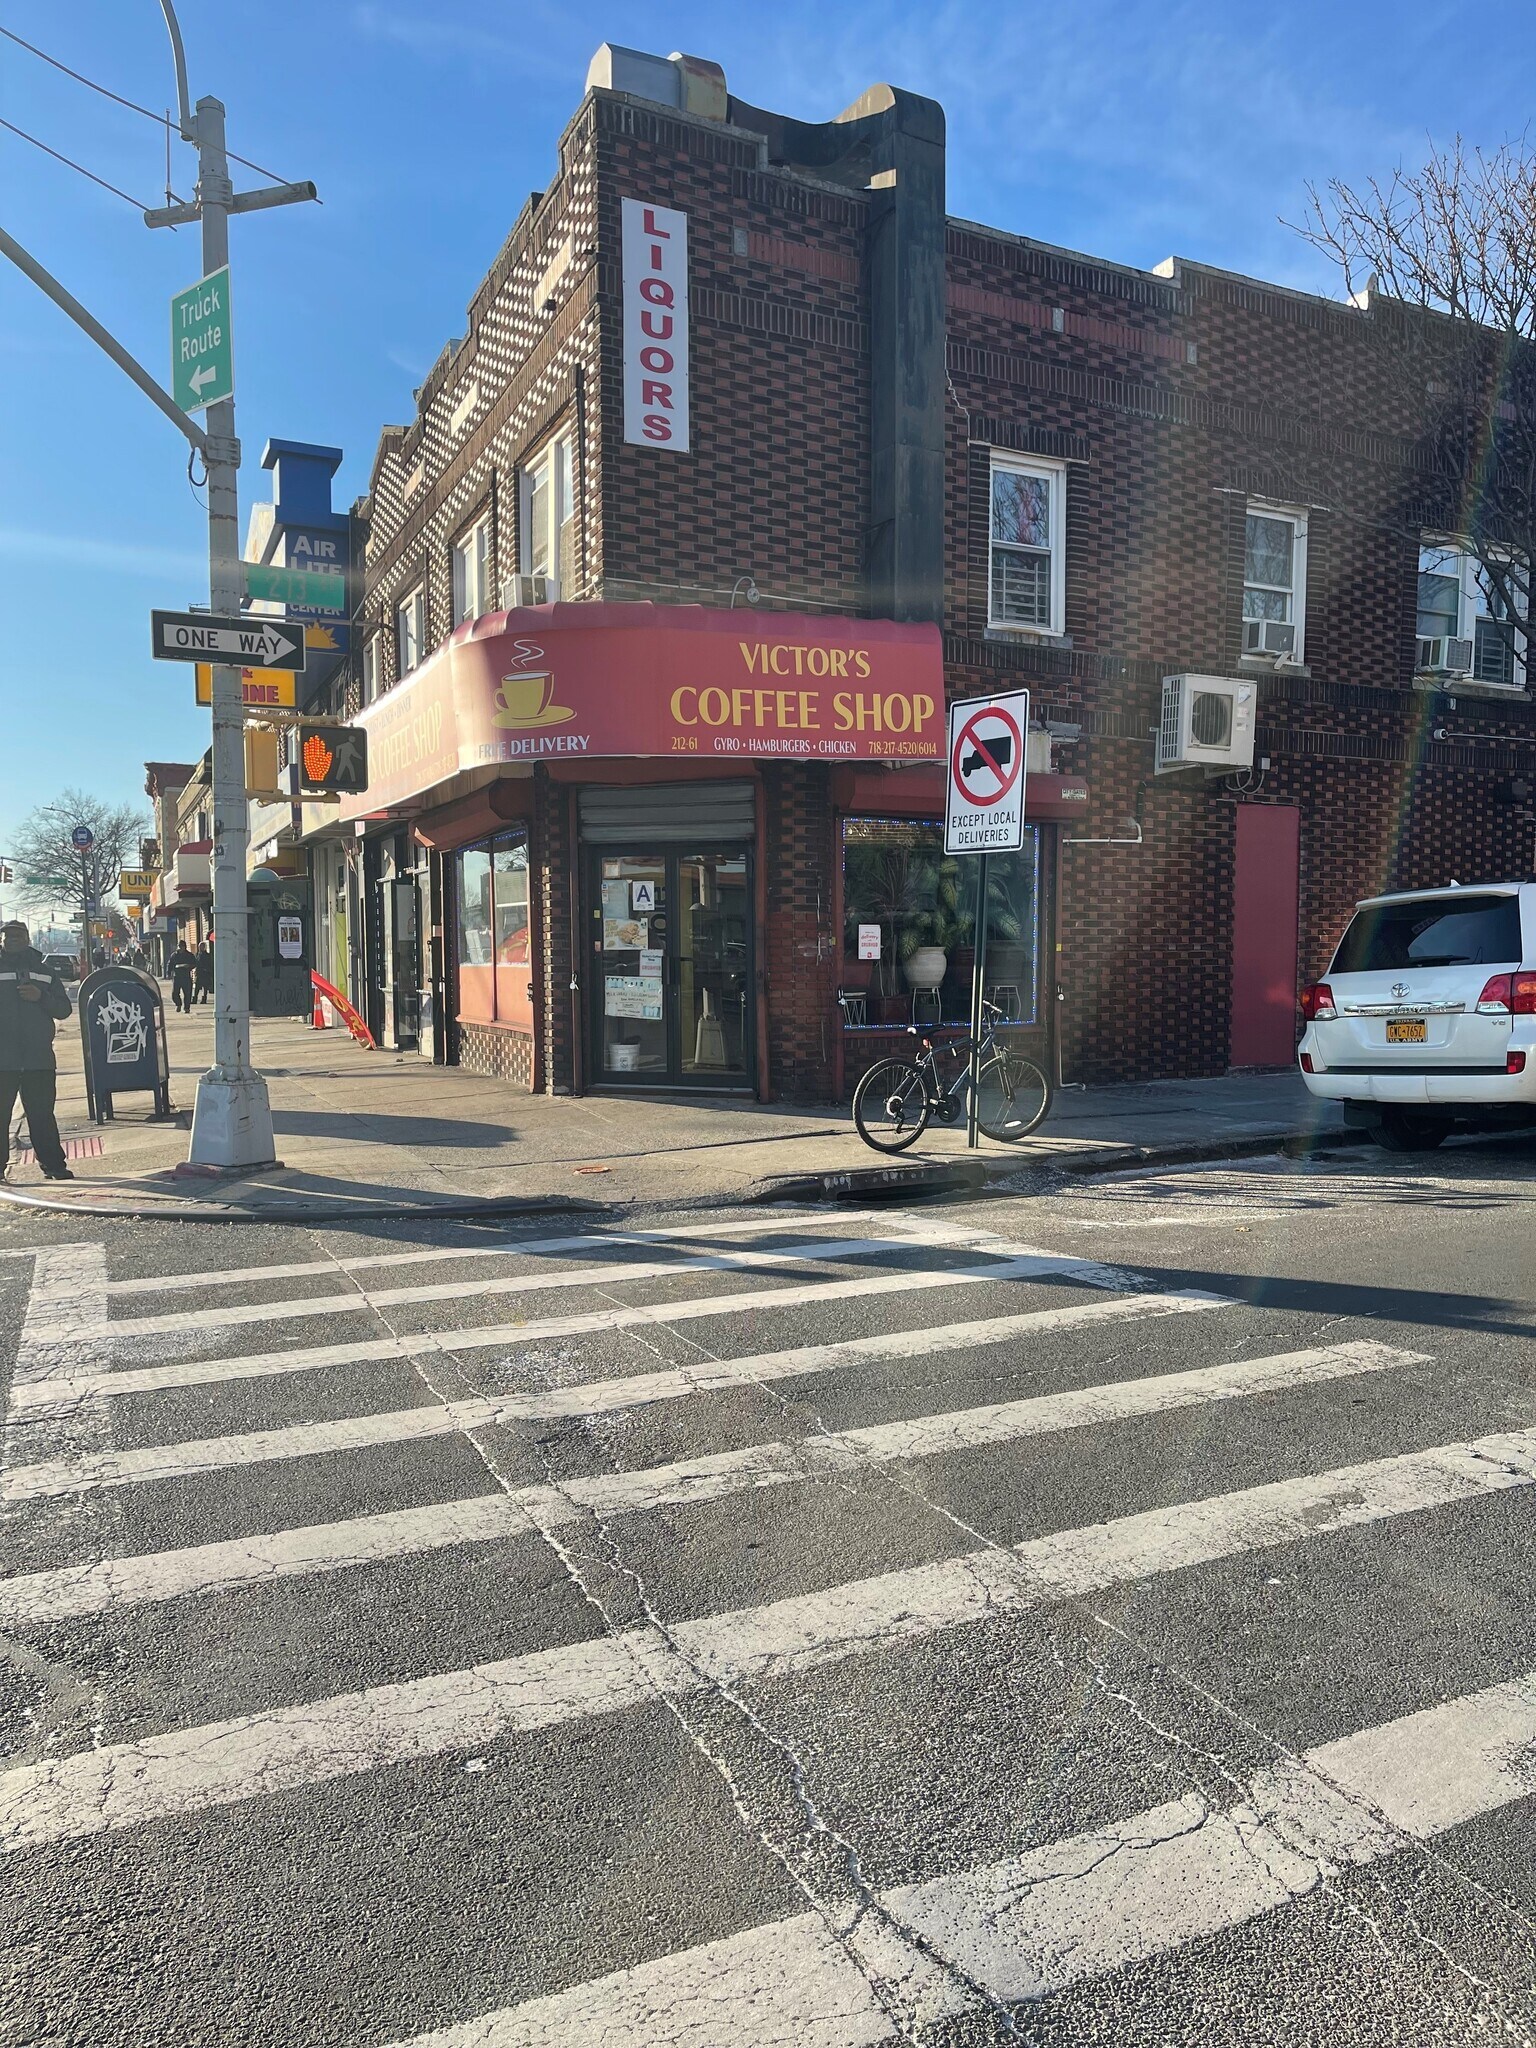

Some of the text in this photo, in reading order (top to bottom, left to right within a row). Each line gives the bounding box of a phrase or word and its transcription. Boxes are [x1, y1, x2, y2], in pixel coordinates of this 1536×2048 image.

[180, 287, 220, 328] Truck
[639, 208, 675, 441] LIQUORS
[181, 324, 222, 362] Route
[293, 535, 336, 558] AIR
[176, 628, 282, 655] ONE WAY
[739, 642, 871, 678] VICTOR'S
[670, 686, 935, 733] COFFEE SHOP
[378, 724, 412, 780] COFFEE
[413, 700, 442, 763] SHOP
[478, 735, 590, 759] FREE DELIVERY
[671, 736, 698, 750] 212-61
[714, 737, 740, 751] GYRO
[748, 738, 811, 753] HAMBURGERS
[818, 739, 856, 754] CHICKEN
[952, 811, 1017, 828] EXCEPT LOCAL
[958, 829, 1009, 844] DELIVERIES
[127, 874, 152, 886] UNI
[636, 884, 651, 902] A
[1405, 1025, 1423, 1038] 7652
